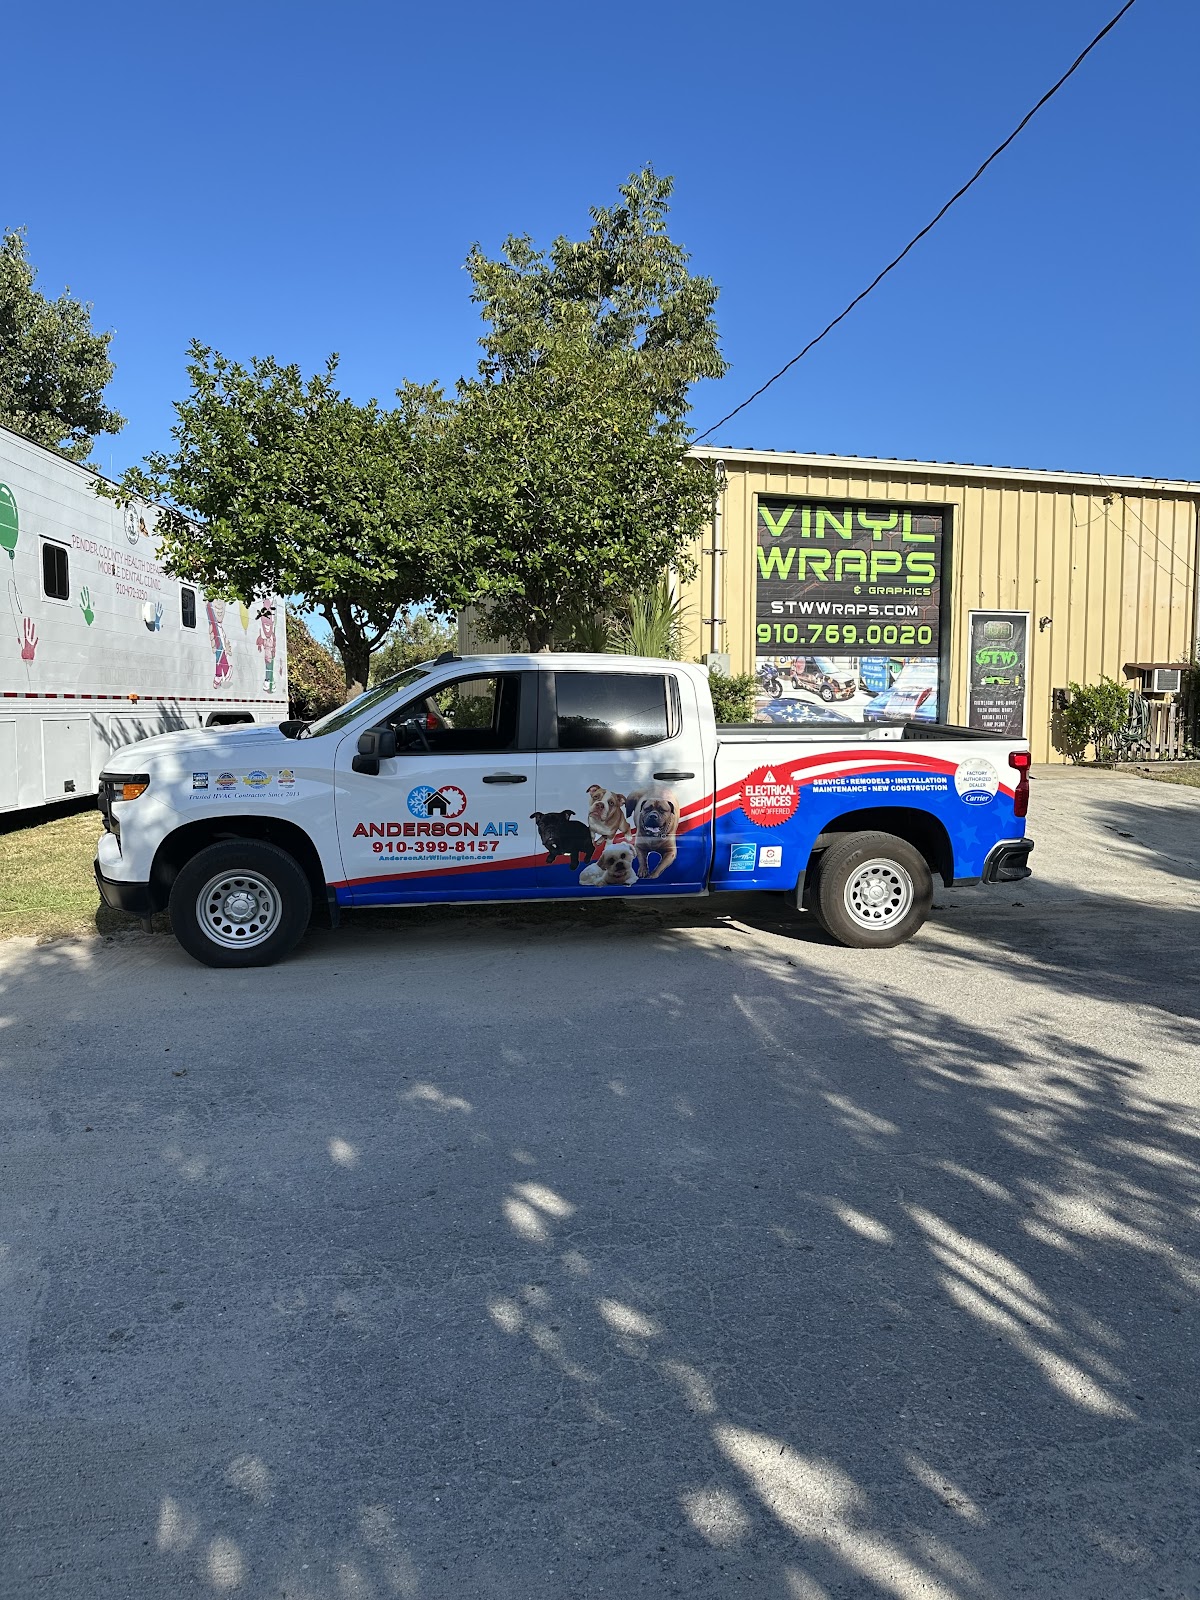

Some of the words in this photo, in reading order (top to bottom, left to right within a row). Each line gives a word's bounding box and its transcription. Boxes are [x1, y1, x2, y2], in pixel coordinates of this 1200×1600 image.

[757, 502, 936, 543] VINYL
[72, 534, 98, 555] PENDER
[98, 544, 124, 564] COUNTY
[124, 554, 146, 573] HEALTH
[757, 545, 937, 585] WRAPS
[121, 567, 143, 585] DENTAL
[143, 576, 161, 591] CLINIC
[868, 586, 932, 596] GRAPHICS
[756, 623, 933, 644] 910.769.0020
[850, 777, 890, 785] REMODELS
[745, 785, 797, 796] ELECTRICAL
[813, 785, 868, 793] MAINTENANCE
[891, 784, 948, 792] CONSTRUCTION
[749, 796, 792, 807] SERVICES
[965, 794, 990, 802] Carrier
[352, 822, 479, 838] ANDERSON
[482, 821, 519, 837] AIR
[372, 840, 500, 853] 910-399-8157
[378, 854, 494, 862] AndersonAirWilmington.com
